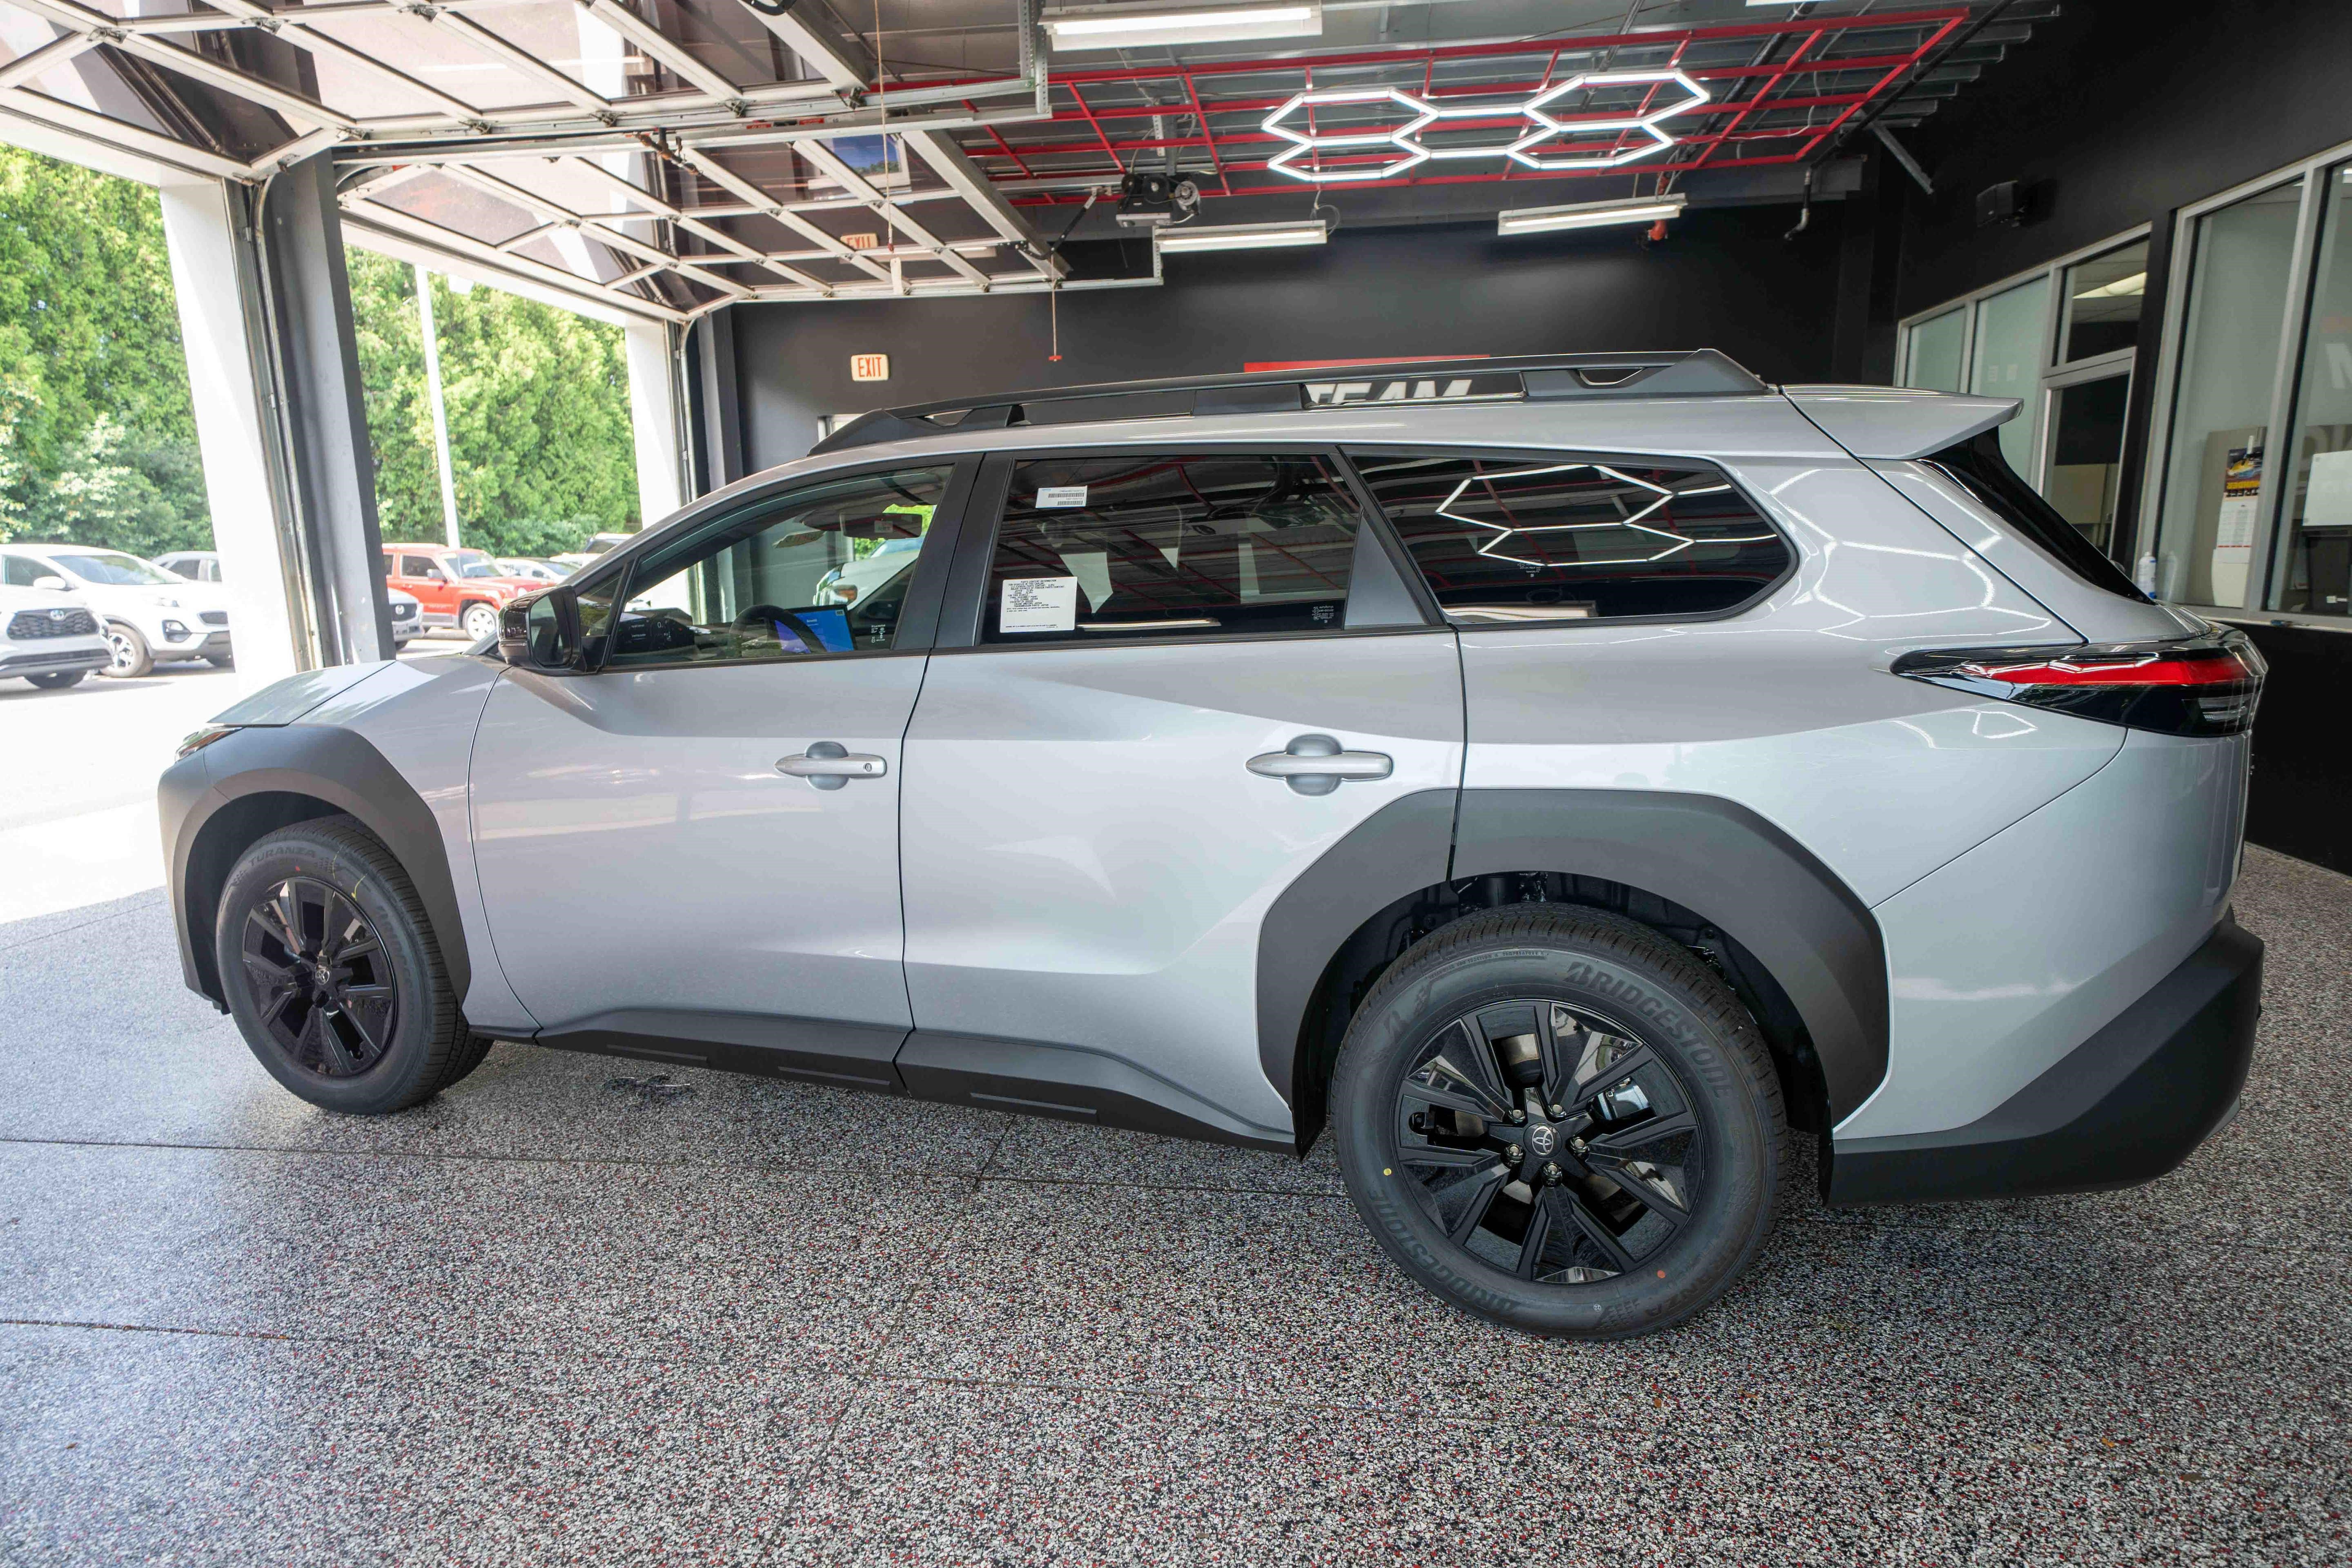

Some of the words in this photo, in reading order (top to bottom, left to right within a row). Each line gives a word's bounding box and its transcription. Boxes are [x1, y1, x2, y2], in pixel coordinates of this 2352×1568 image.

[858, 356, 882, 377] EXIT
[249, 845, 316, 866] TURANZA
[1563, 960, 1735, 1099] BRIDGESTONE
[1368, 1189, 1521, 1311] BRIDGESTONE
